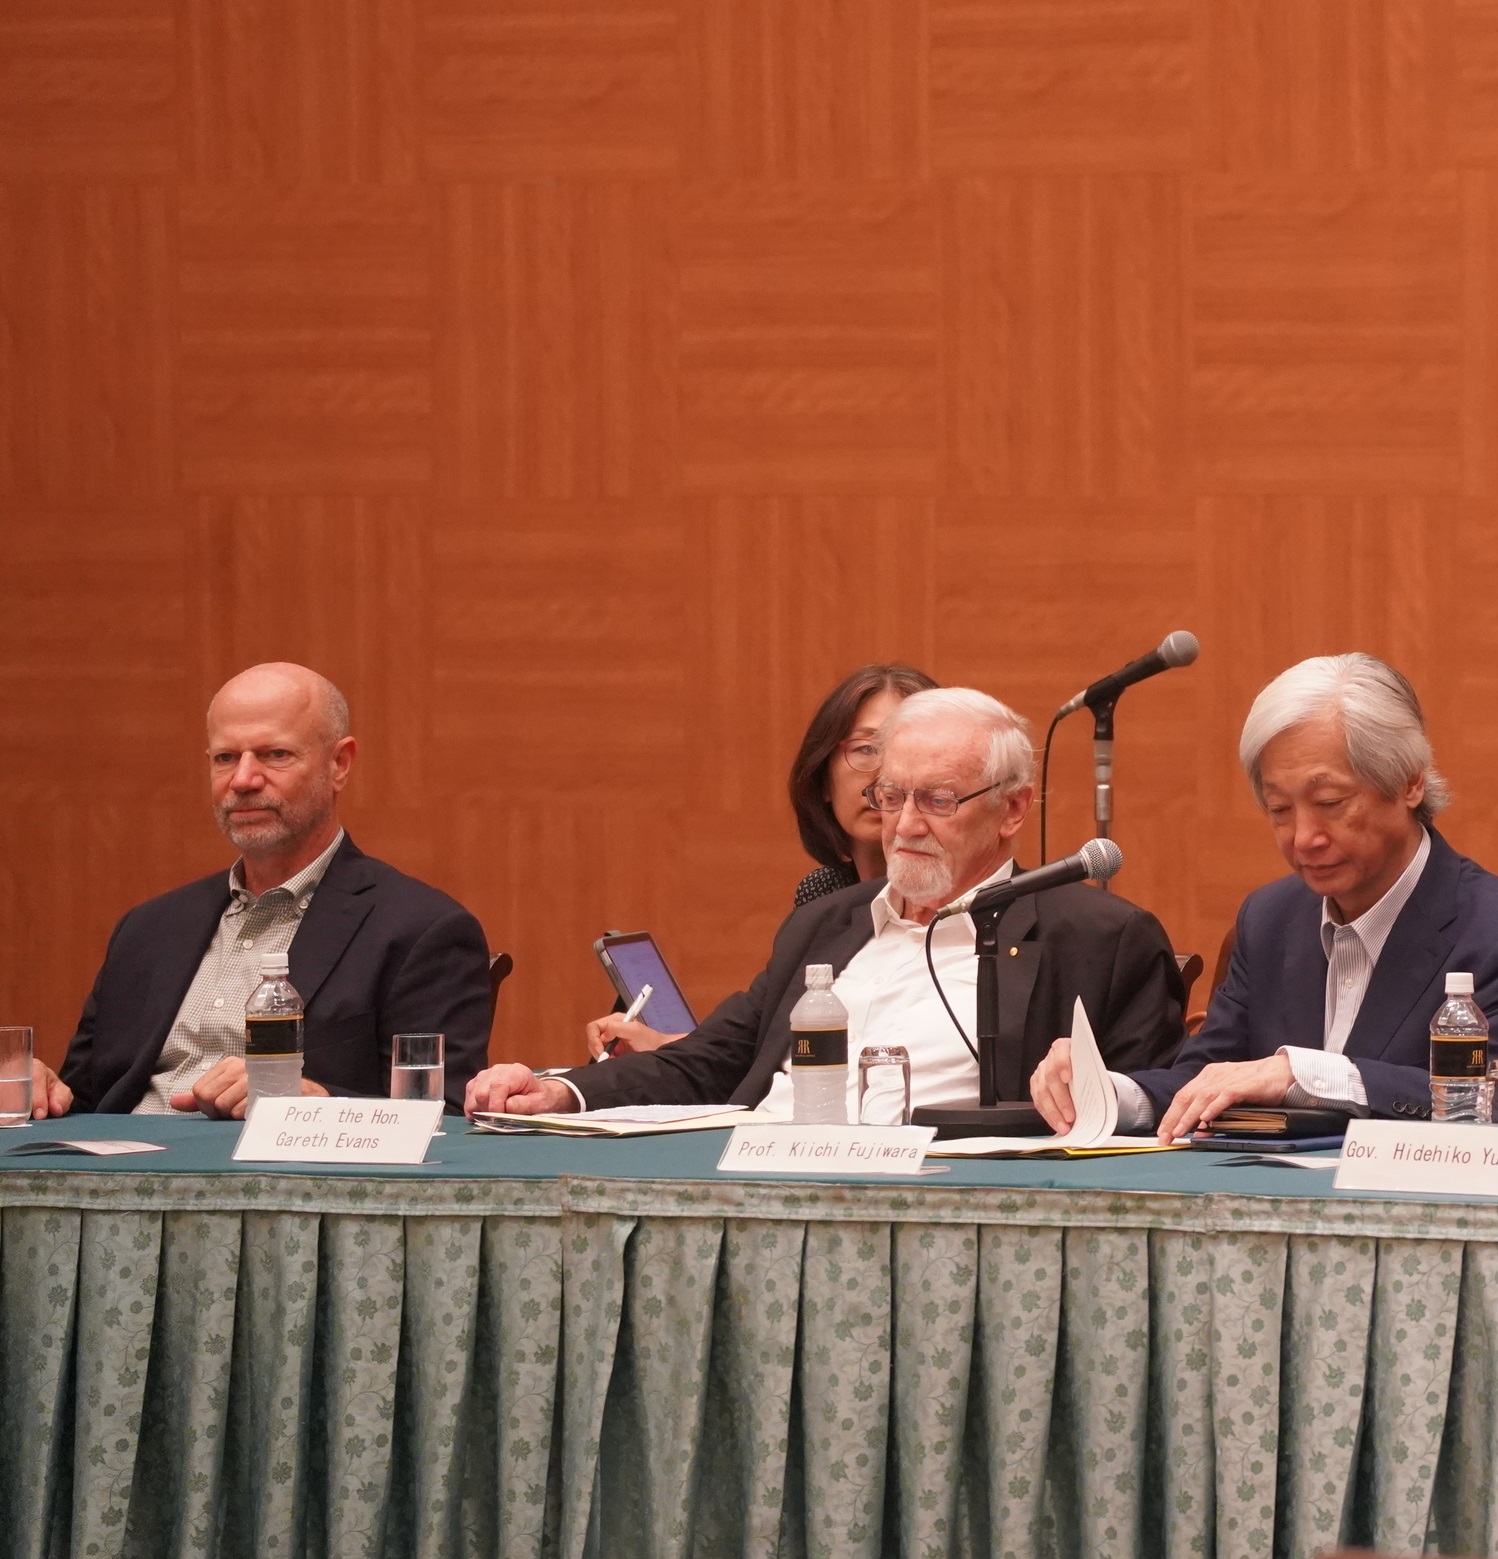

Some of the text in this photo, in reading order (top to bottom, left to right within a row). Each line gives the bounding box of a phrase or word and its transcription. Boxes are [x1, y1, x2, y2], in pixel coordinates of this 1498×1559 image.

[284, 1106, 400, 1125] Prof. the Hon.
[276, 1131, 380, 1149] Gareth Evans
[738, 1141, 919, 1160] Prof. Kiichi Fujiwara
[1346, 1140, 1378, 1159] Gov.
[1392, 1142, 1472, 1164] Hidehiko
